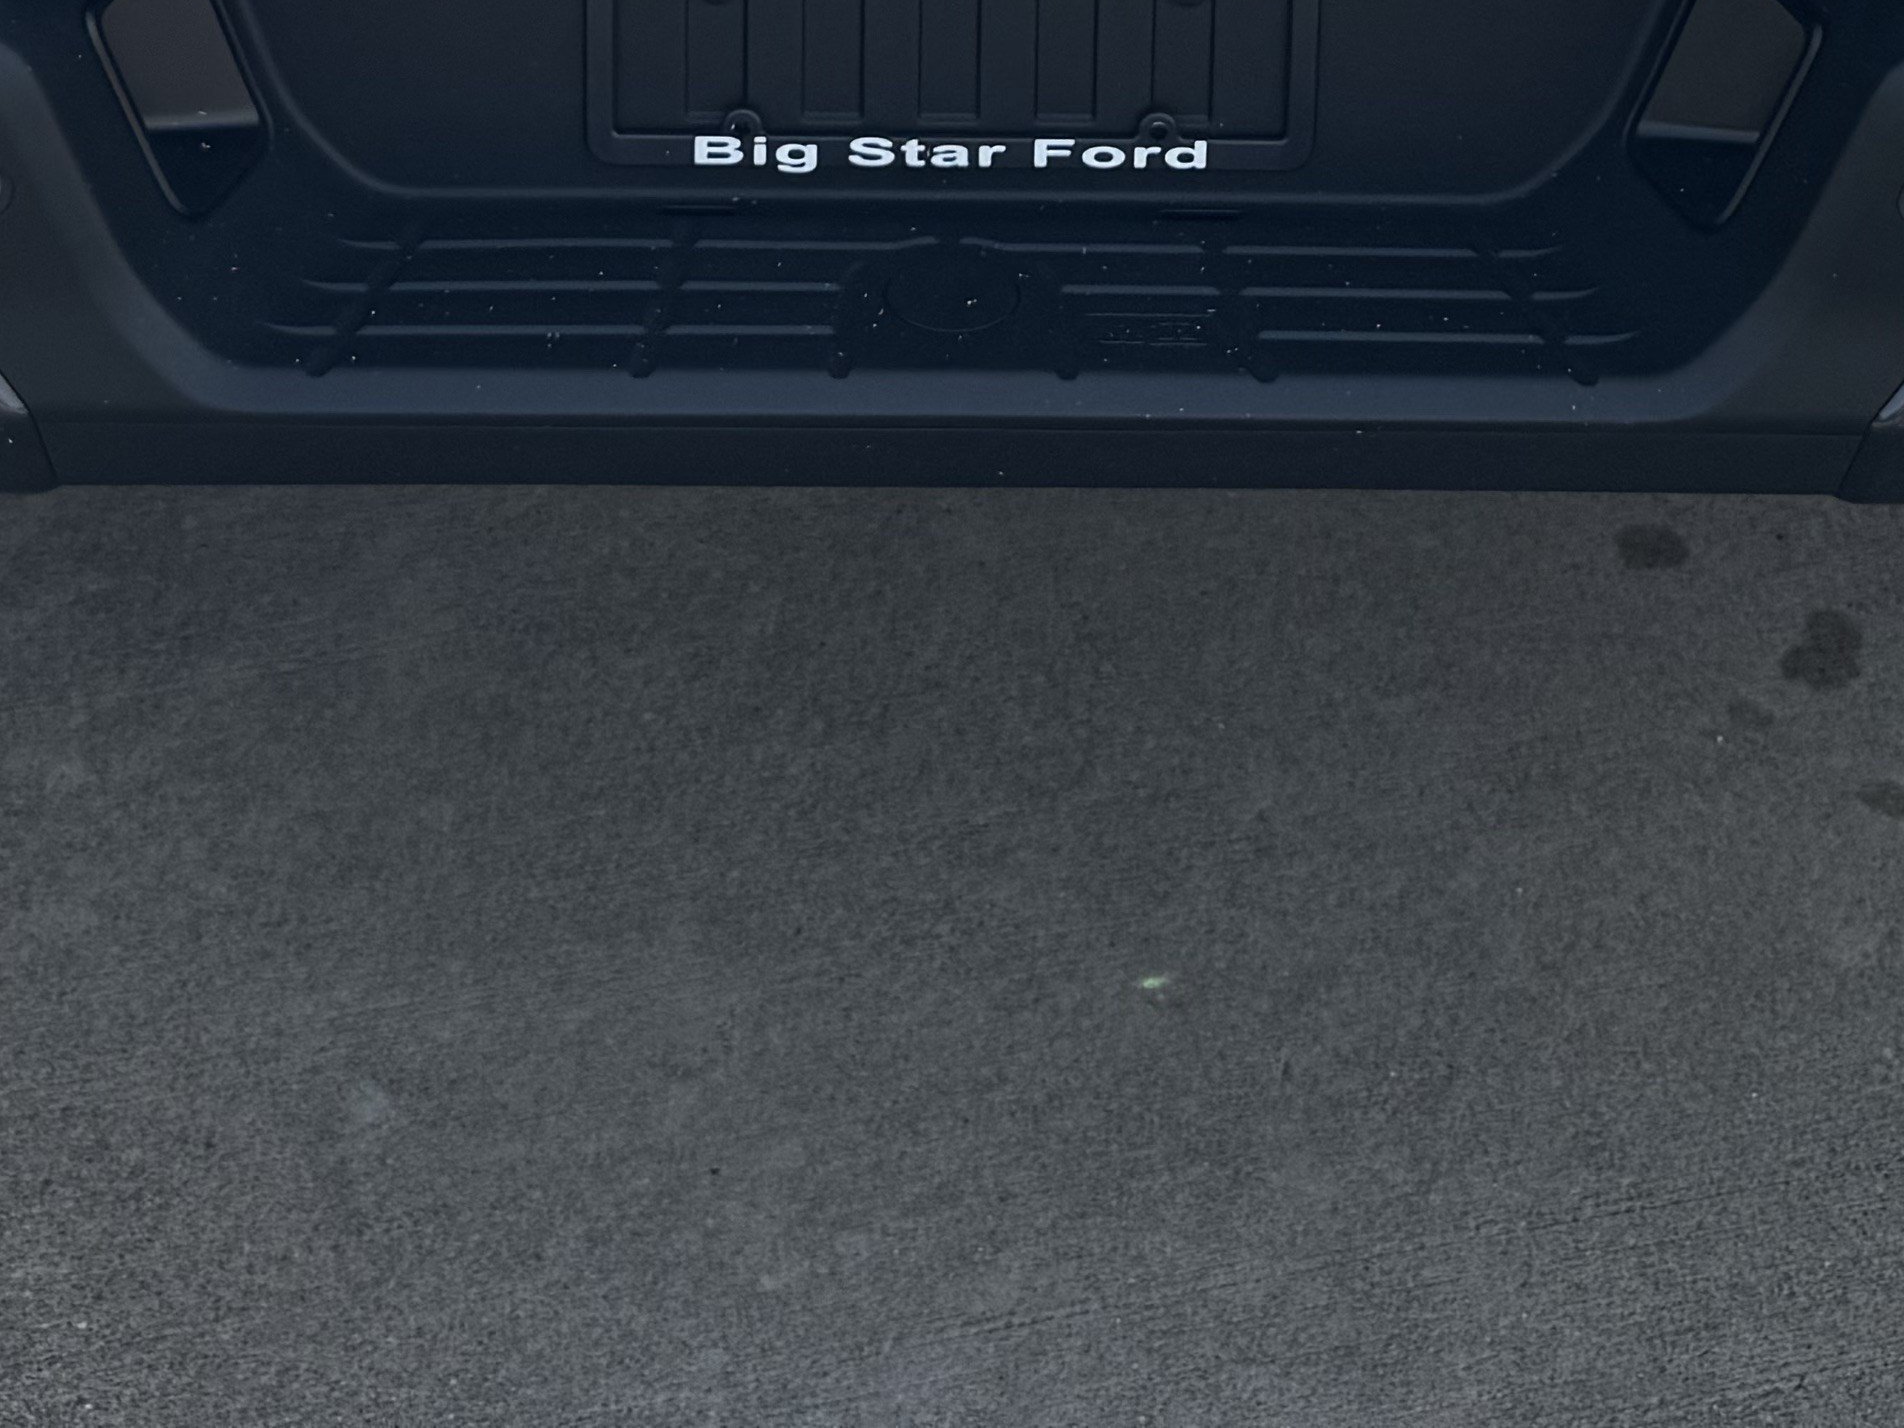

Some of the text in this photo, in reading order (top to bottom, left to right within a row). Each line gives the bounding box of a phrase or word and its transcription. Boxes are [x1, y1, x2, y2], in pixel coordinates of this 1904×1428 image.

[693, 135, 1209, 173] Big Star Ford
